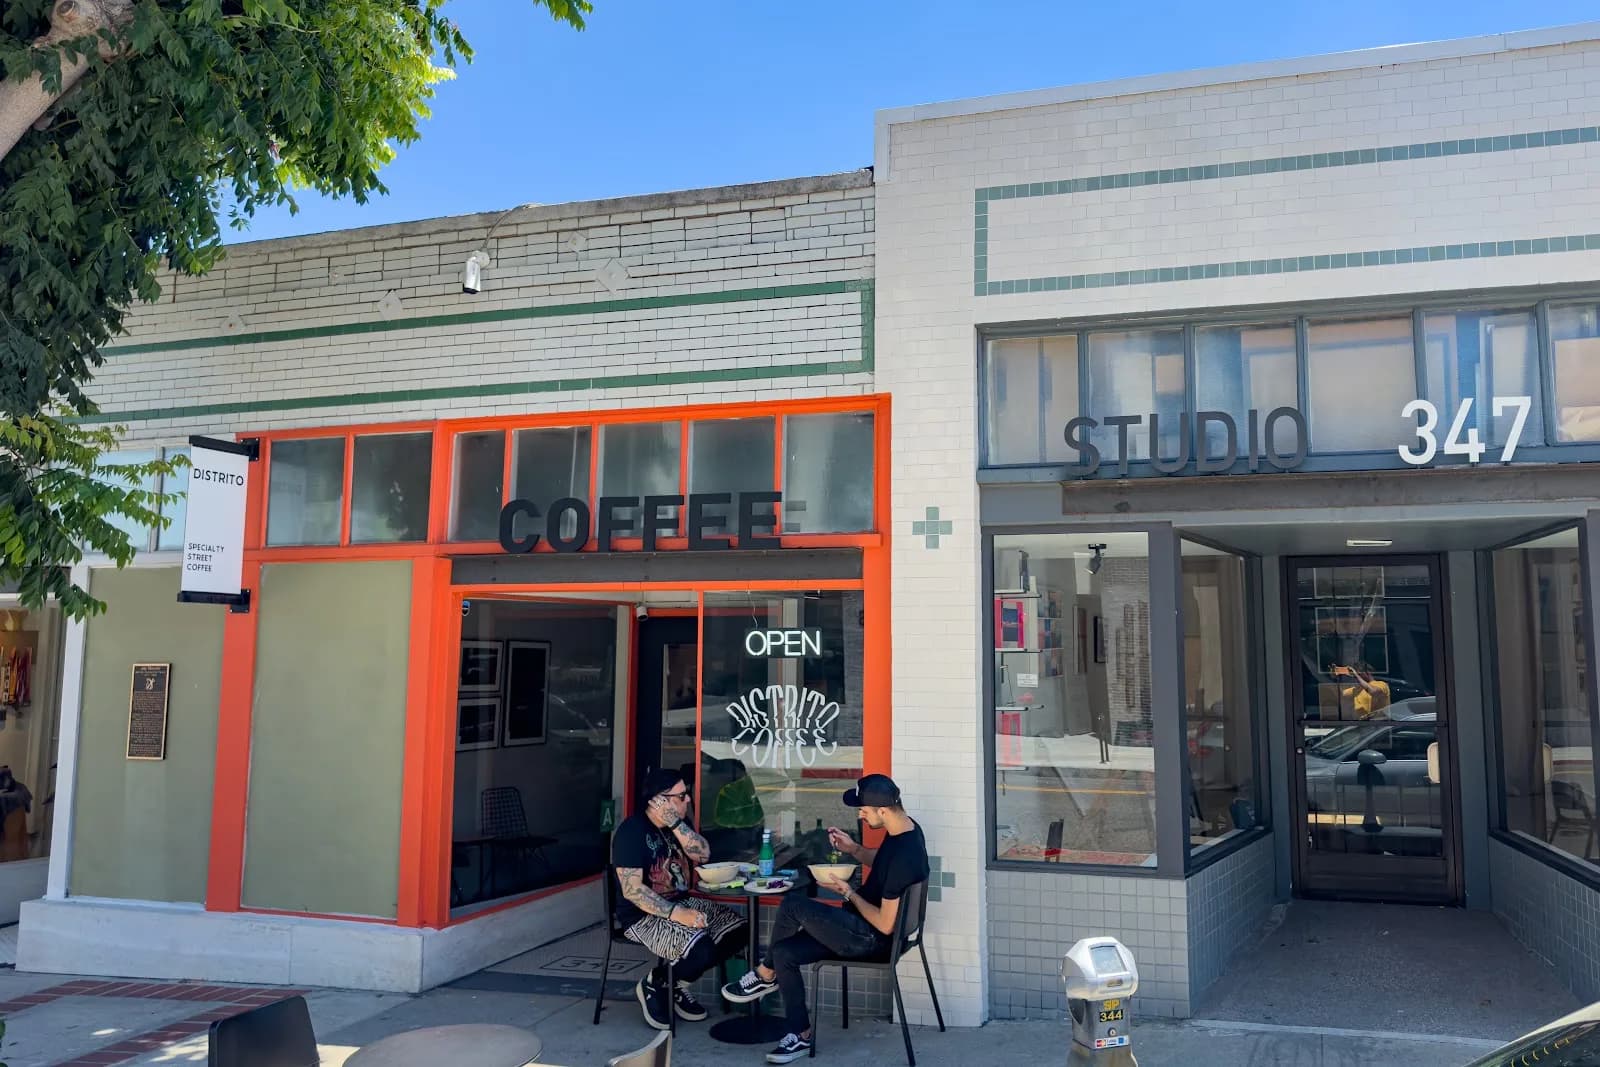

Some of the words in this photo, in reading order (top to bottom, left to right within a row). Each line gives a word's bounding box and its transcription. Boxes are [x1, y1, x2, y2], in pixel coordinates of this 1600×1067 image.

[1064, 406, 1307, 476] STUDIO
[1398, 396, 1532, 465] 347
[193, 468, 244, 486] DISTRITO
[499, 491, 783, 554] COFFEE
[187, 553, 212, 562] STREET
[188, 542, 225, 553] SPECIALTY
[186, 563, 212, 572] COFFEE
[745, 630, 821, 656] OPEN
[726, 685, 840, 729] DISTRITO
[731, 727, 838, 769] COFFEE
[1100, 1009, 1122, 1022] 344
